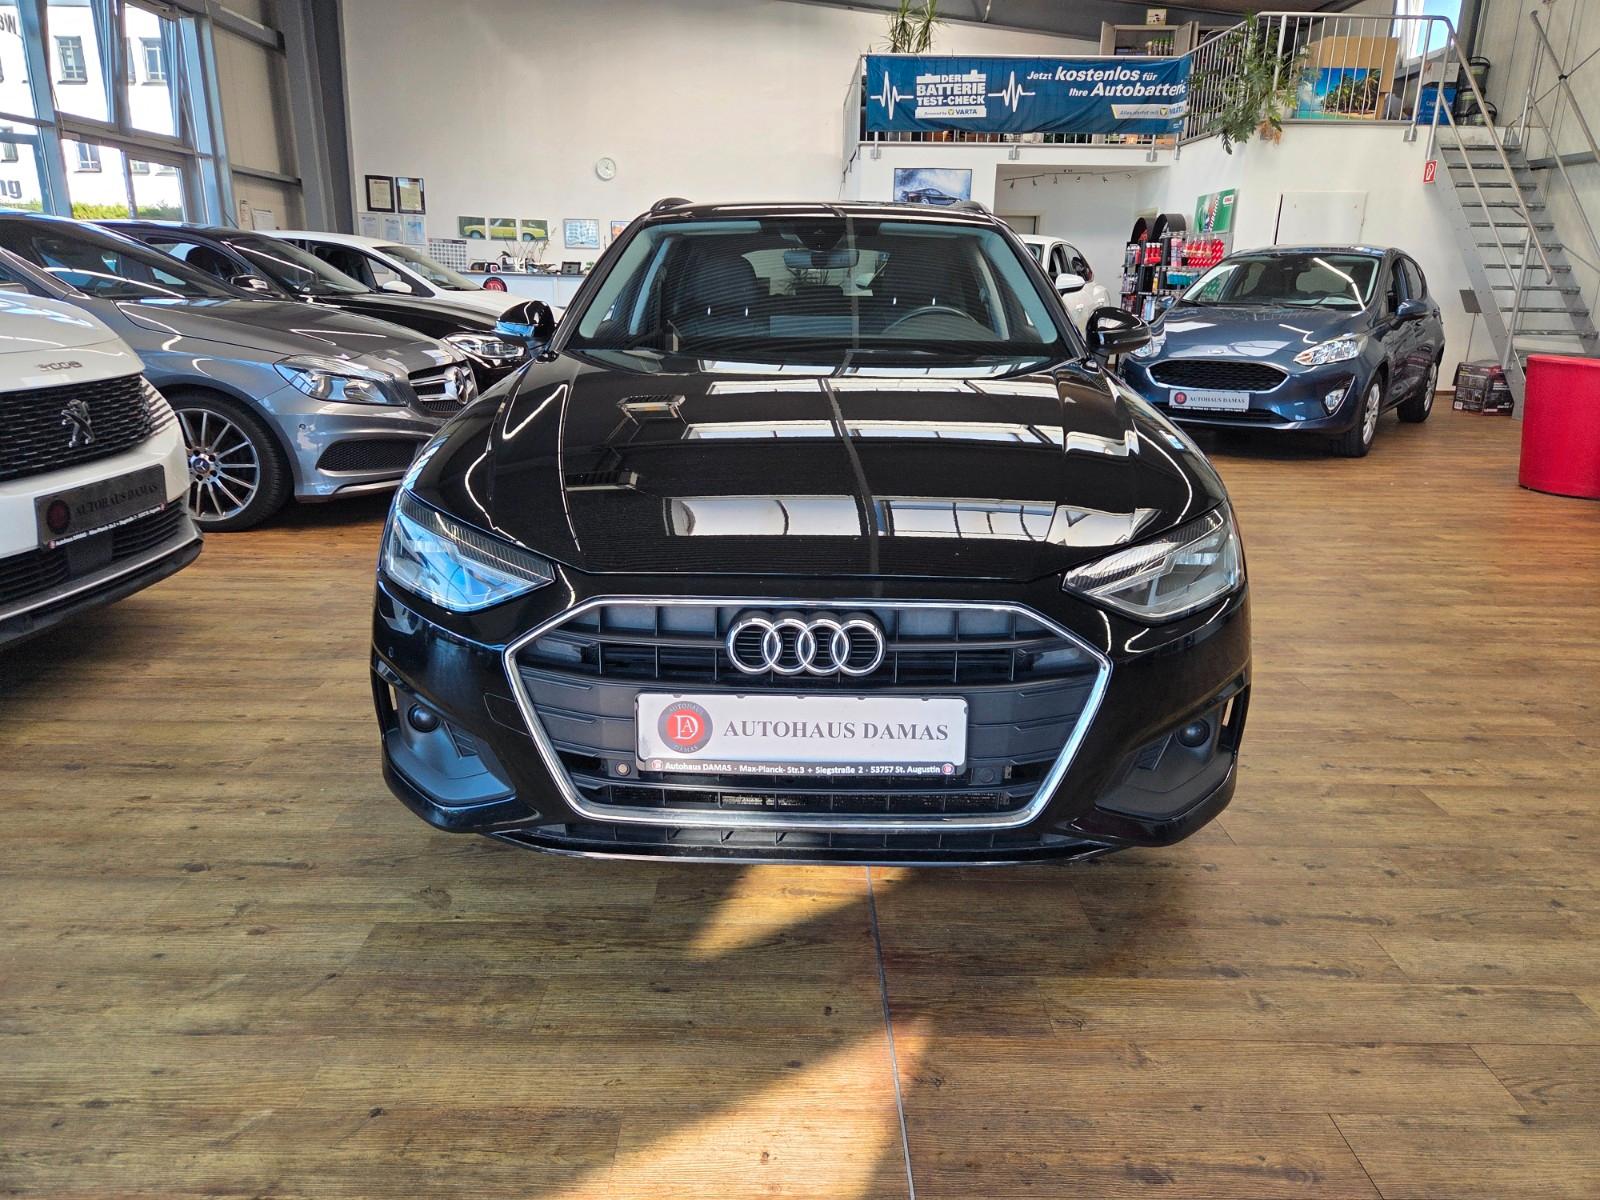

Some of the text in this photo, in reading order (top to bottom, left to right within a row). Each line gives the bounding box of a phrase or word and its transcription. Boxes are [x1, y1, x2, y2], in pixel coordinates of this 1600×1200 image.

[941, 74, 962, 83] DER
[1027, 66, 1158, 81] Jetzt kostenlos für
[916, 83, 986, 96] BATTERIE
[1069, 88, 1088, 97] Ihre
[916, 95, 985, 106] TEST-CHECK
[724, 720, 949, 741] AUTOHAUS DAMAS
[665, 762, 701, 771] Autohaus
[703, 763, 732, 772] DAMAS
[815, 765, 856, 776] Siegstraße
[858, 766, 863, 774] 2
[870, 765, 894, 774] 53757
[895, 765, 905, 774] St.
[907, 765, 941, 775] Augustin
